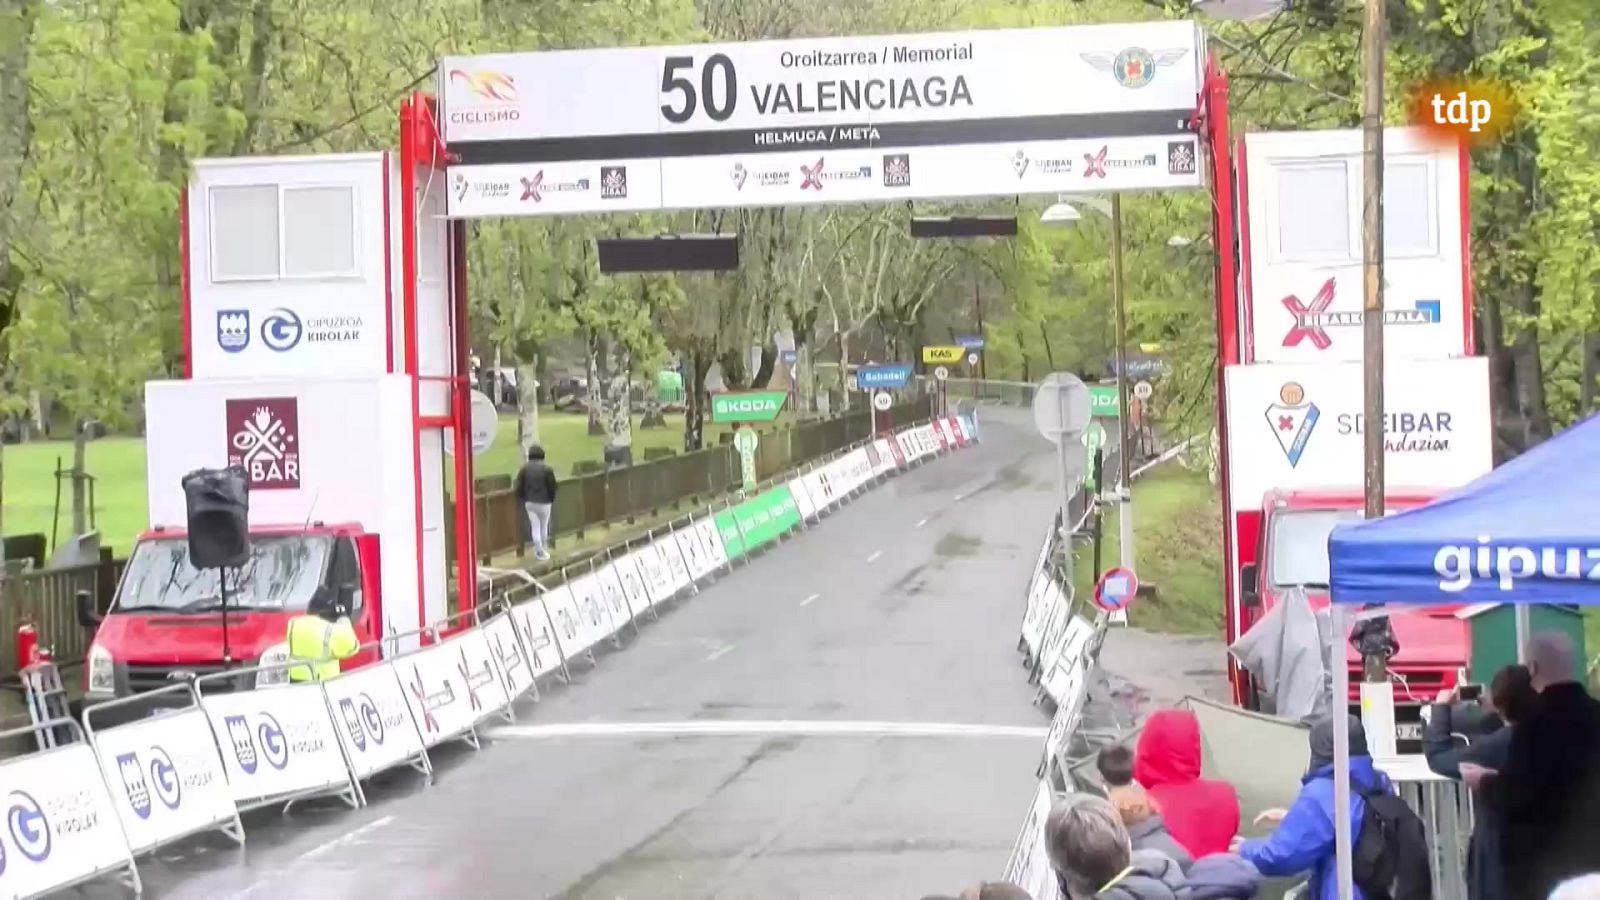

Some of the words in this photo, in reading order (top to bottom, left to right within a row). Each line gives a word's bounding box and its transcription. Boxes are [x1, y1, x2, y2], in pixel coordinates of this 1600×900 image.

[780, 50, 877, 68] Oroitzarrea
[893, 42, 973, 63] Memorial
[660, 53, 737, 123] 50
[750, 75, 974, 115] VALENCIAGA
[451, 110, 520, 124] CICLISMO
[754, 130, 827, 145] HELMUGA
[839, 127, 881, 140] META
[308, 331, 360, 342] KIROLAK
[930, 350, 952, 358] KAS
